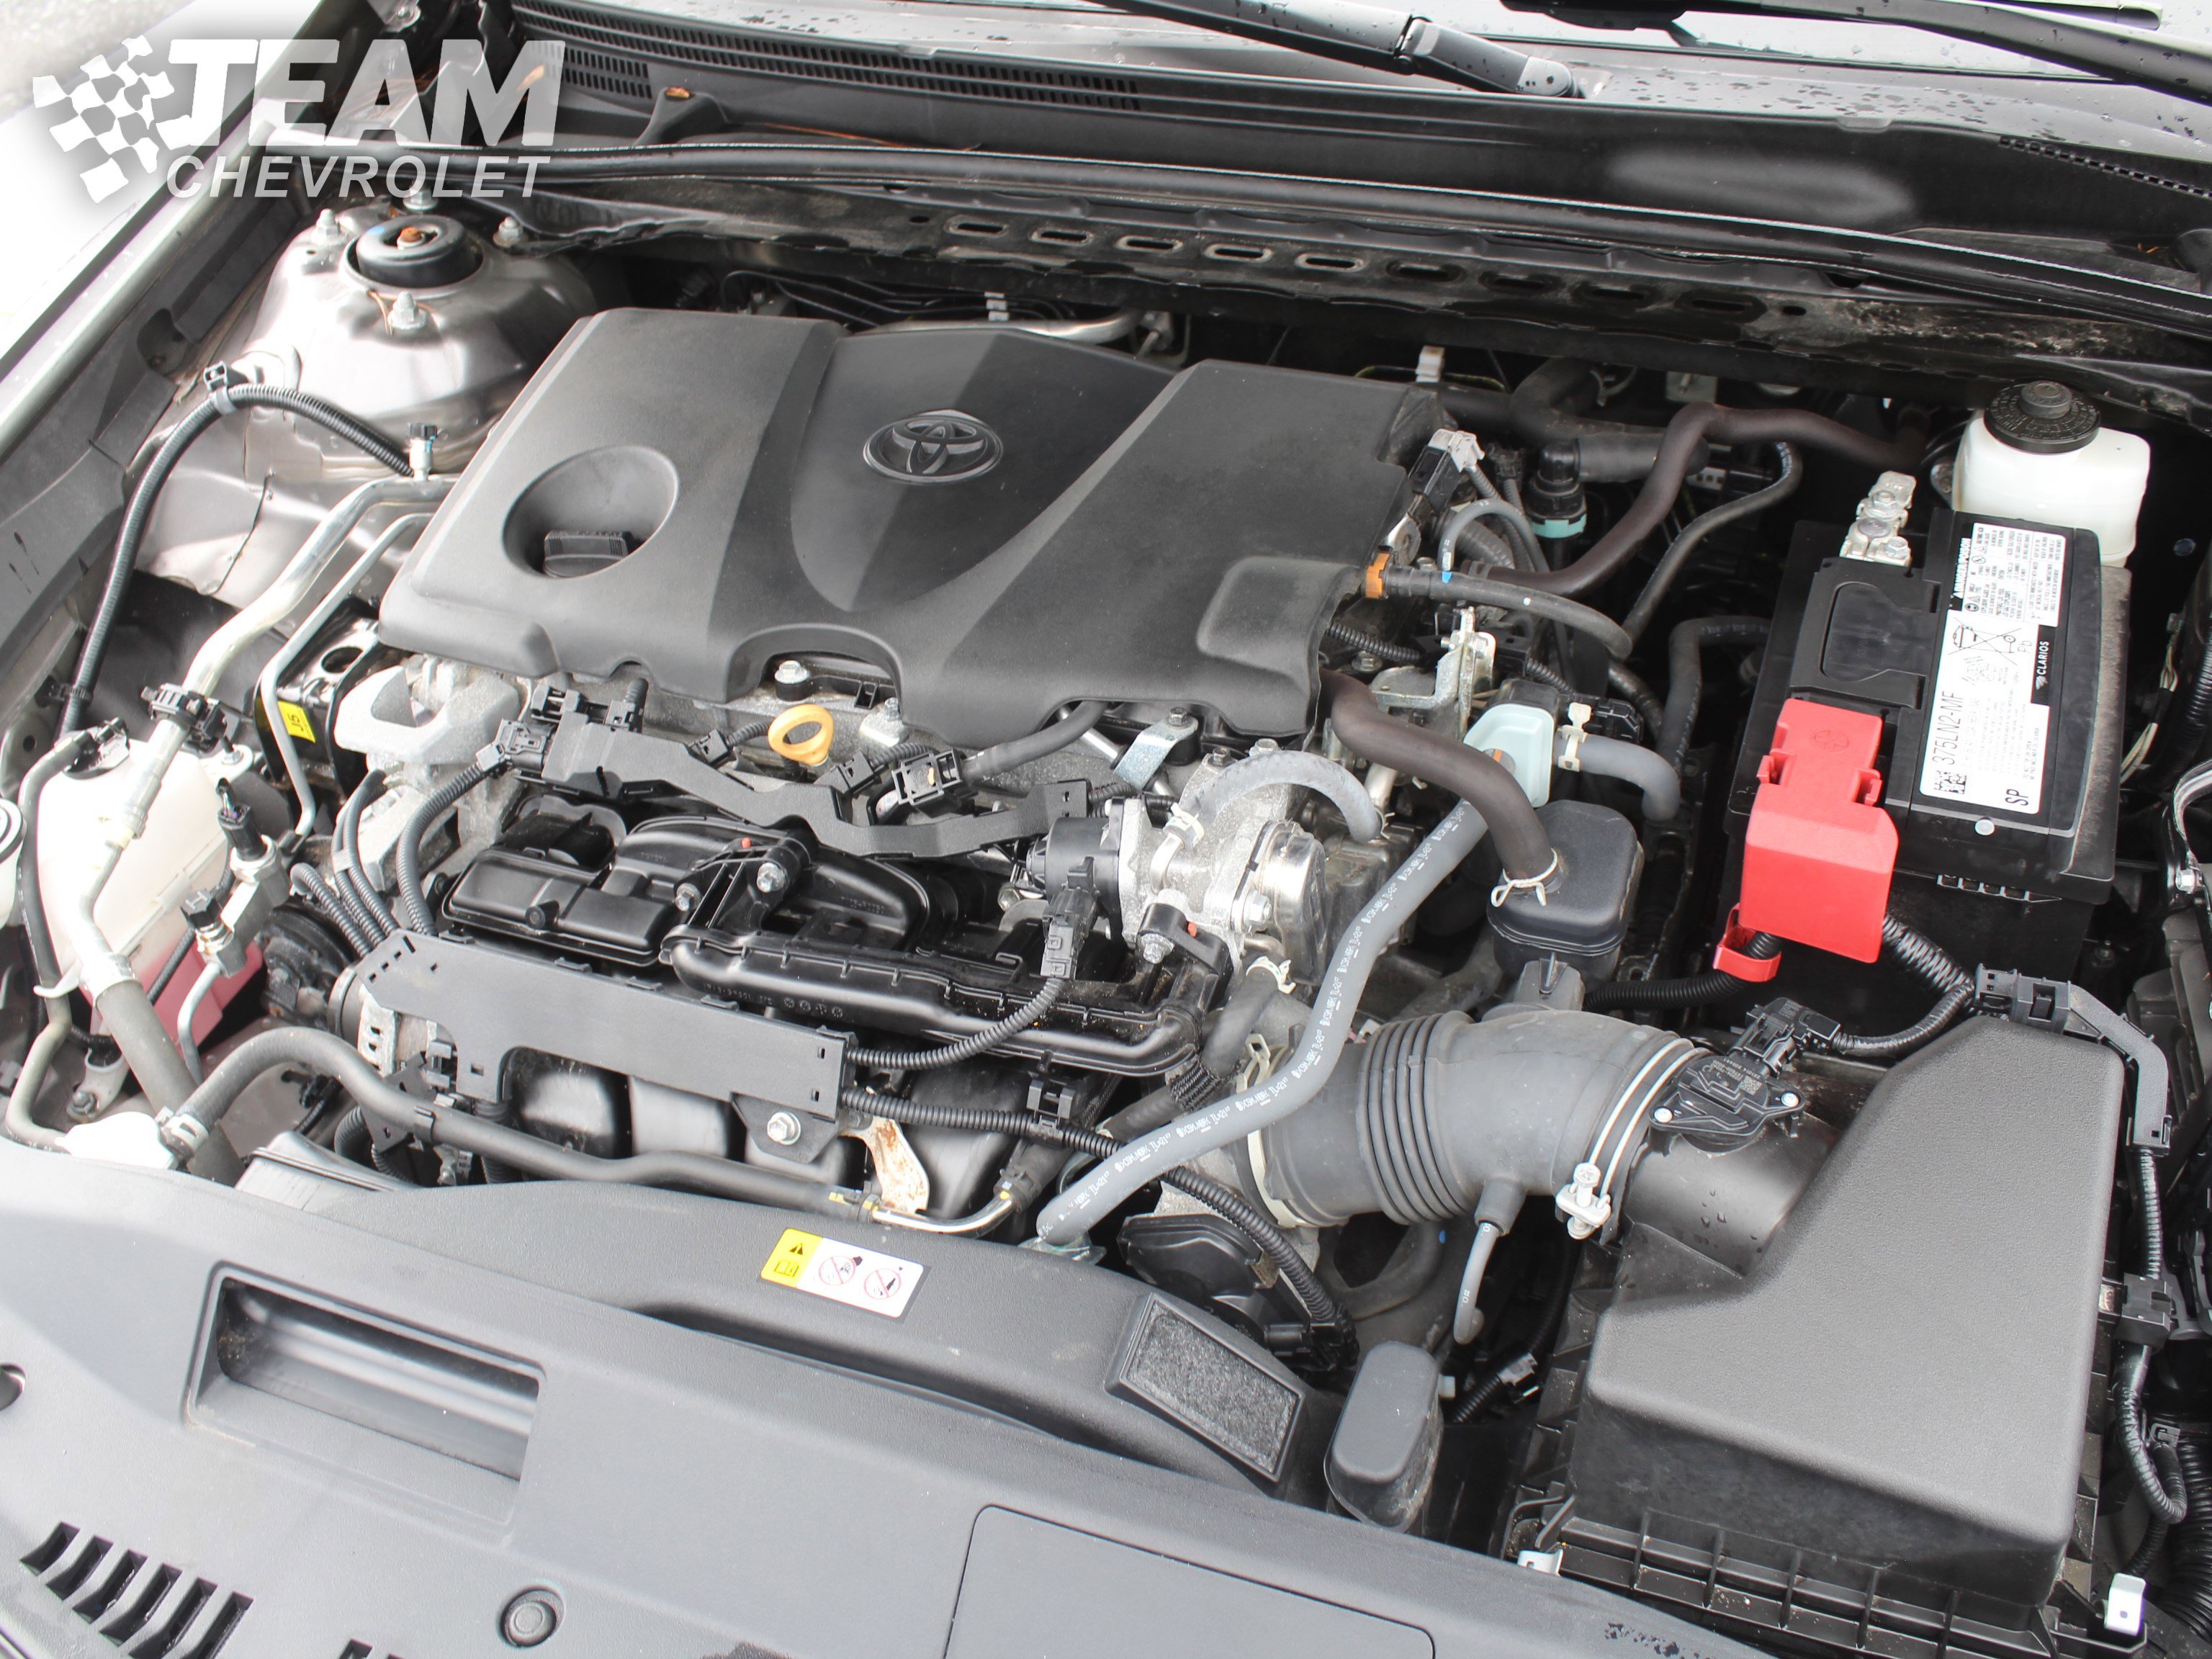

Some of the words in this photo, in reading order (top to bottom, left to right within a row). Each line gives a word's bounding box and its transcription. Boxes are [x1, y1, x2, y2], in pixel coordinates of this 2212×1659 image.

[2017, 639, 2032, 653] Pb
[2036, 640, 2049, 675] CLARIOS
[1933, 691, 1964, 765] 375LN2-MF
[2005, 788, 2029, 806] SP
